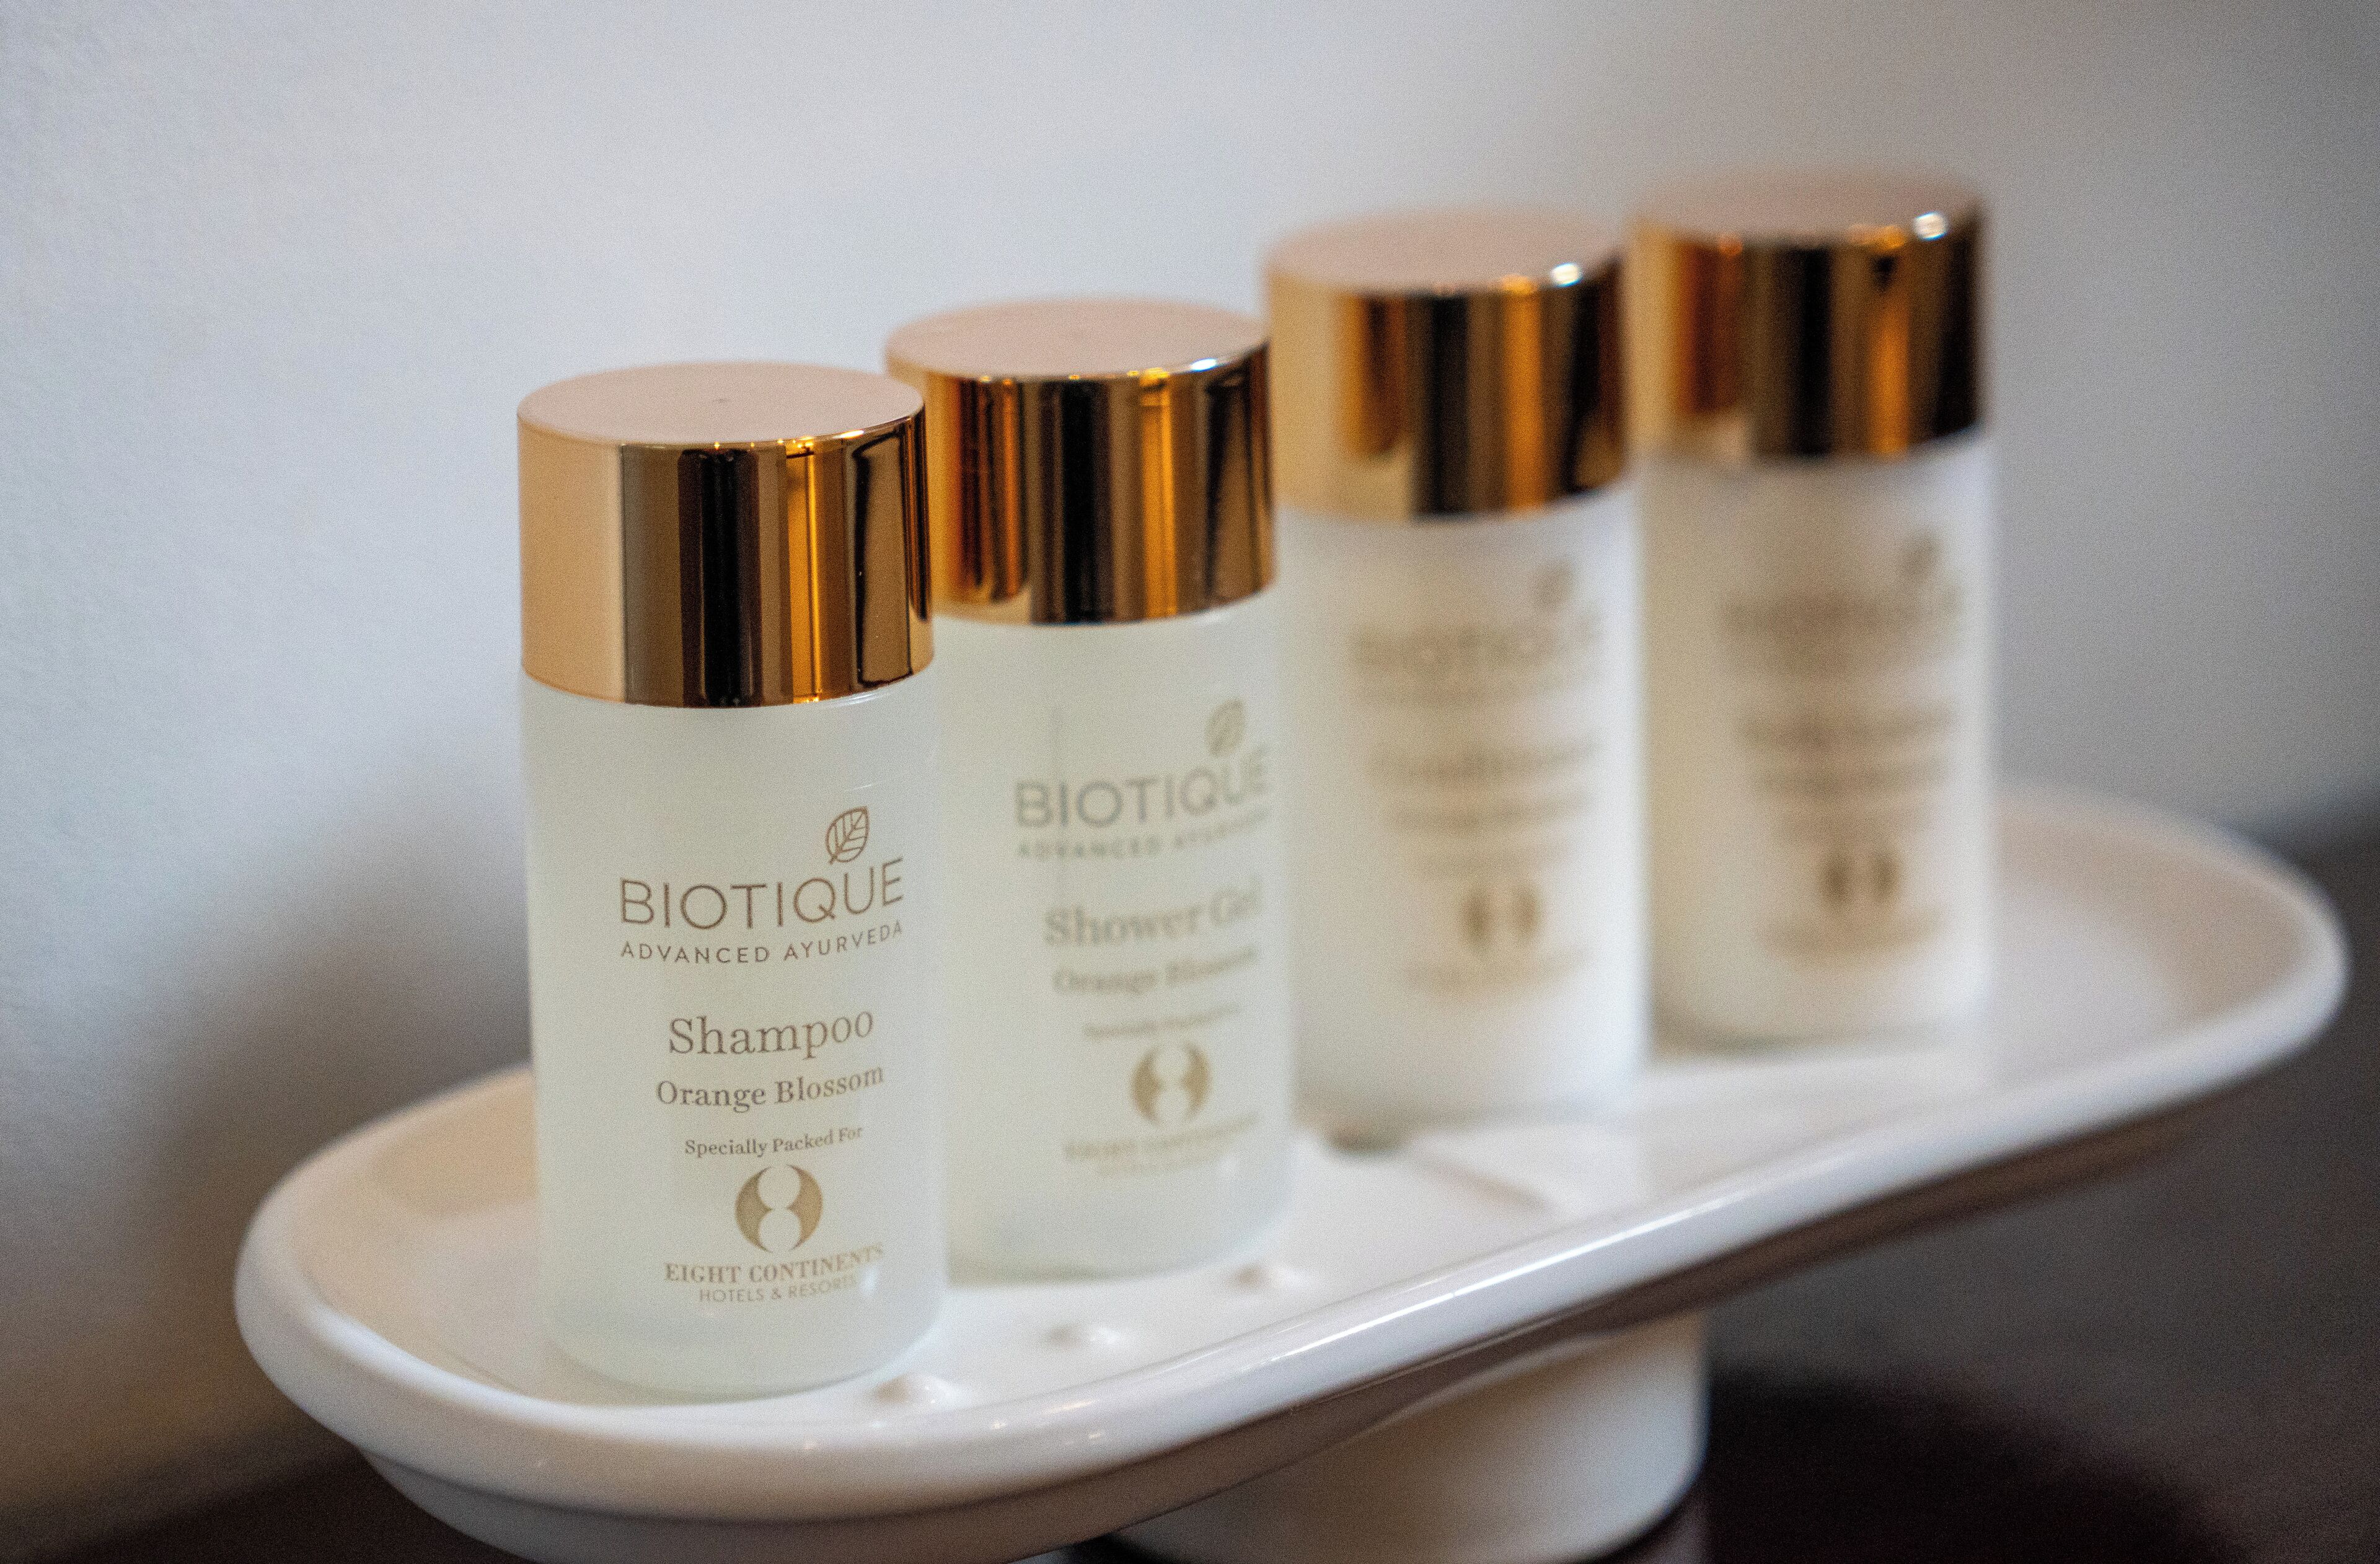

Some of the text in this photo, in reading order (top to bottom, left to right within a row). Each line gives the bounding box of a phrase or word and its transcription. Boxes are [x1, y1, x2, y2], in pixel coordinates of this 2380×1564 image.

[1015, 744, 1269, 828] BIOTIQUE
[621, 858, 904, 929] BIOTIQUE
[620, 920, 903, 964] ADVANCED AYURVEDA
[1044, 901, 1202, 947] Shower
[669, 1011, 874, 1060] Shampoo
[657, 1066, 884, 1114] Orange Blossom
[685, 1126, 863, 1159] Specially Packed For
[665, 1242, 884, 1284] EIGHT CONTINENTS
[699, 1287, 765, 1303] HOTELS
[770, 1286, 782, 1300] &
